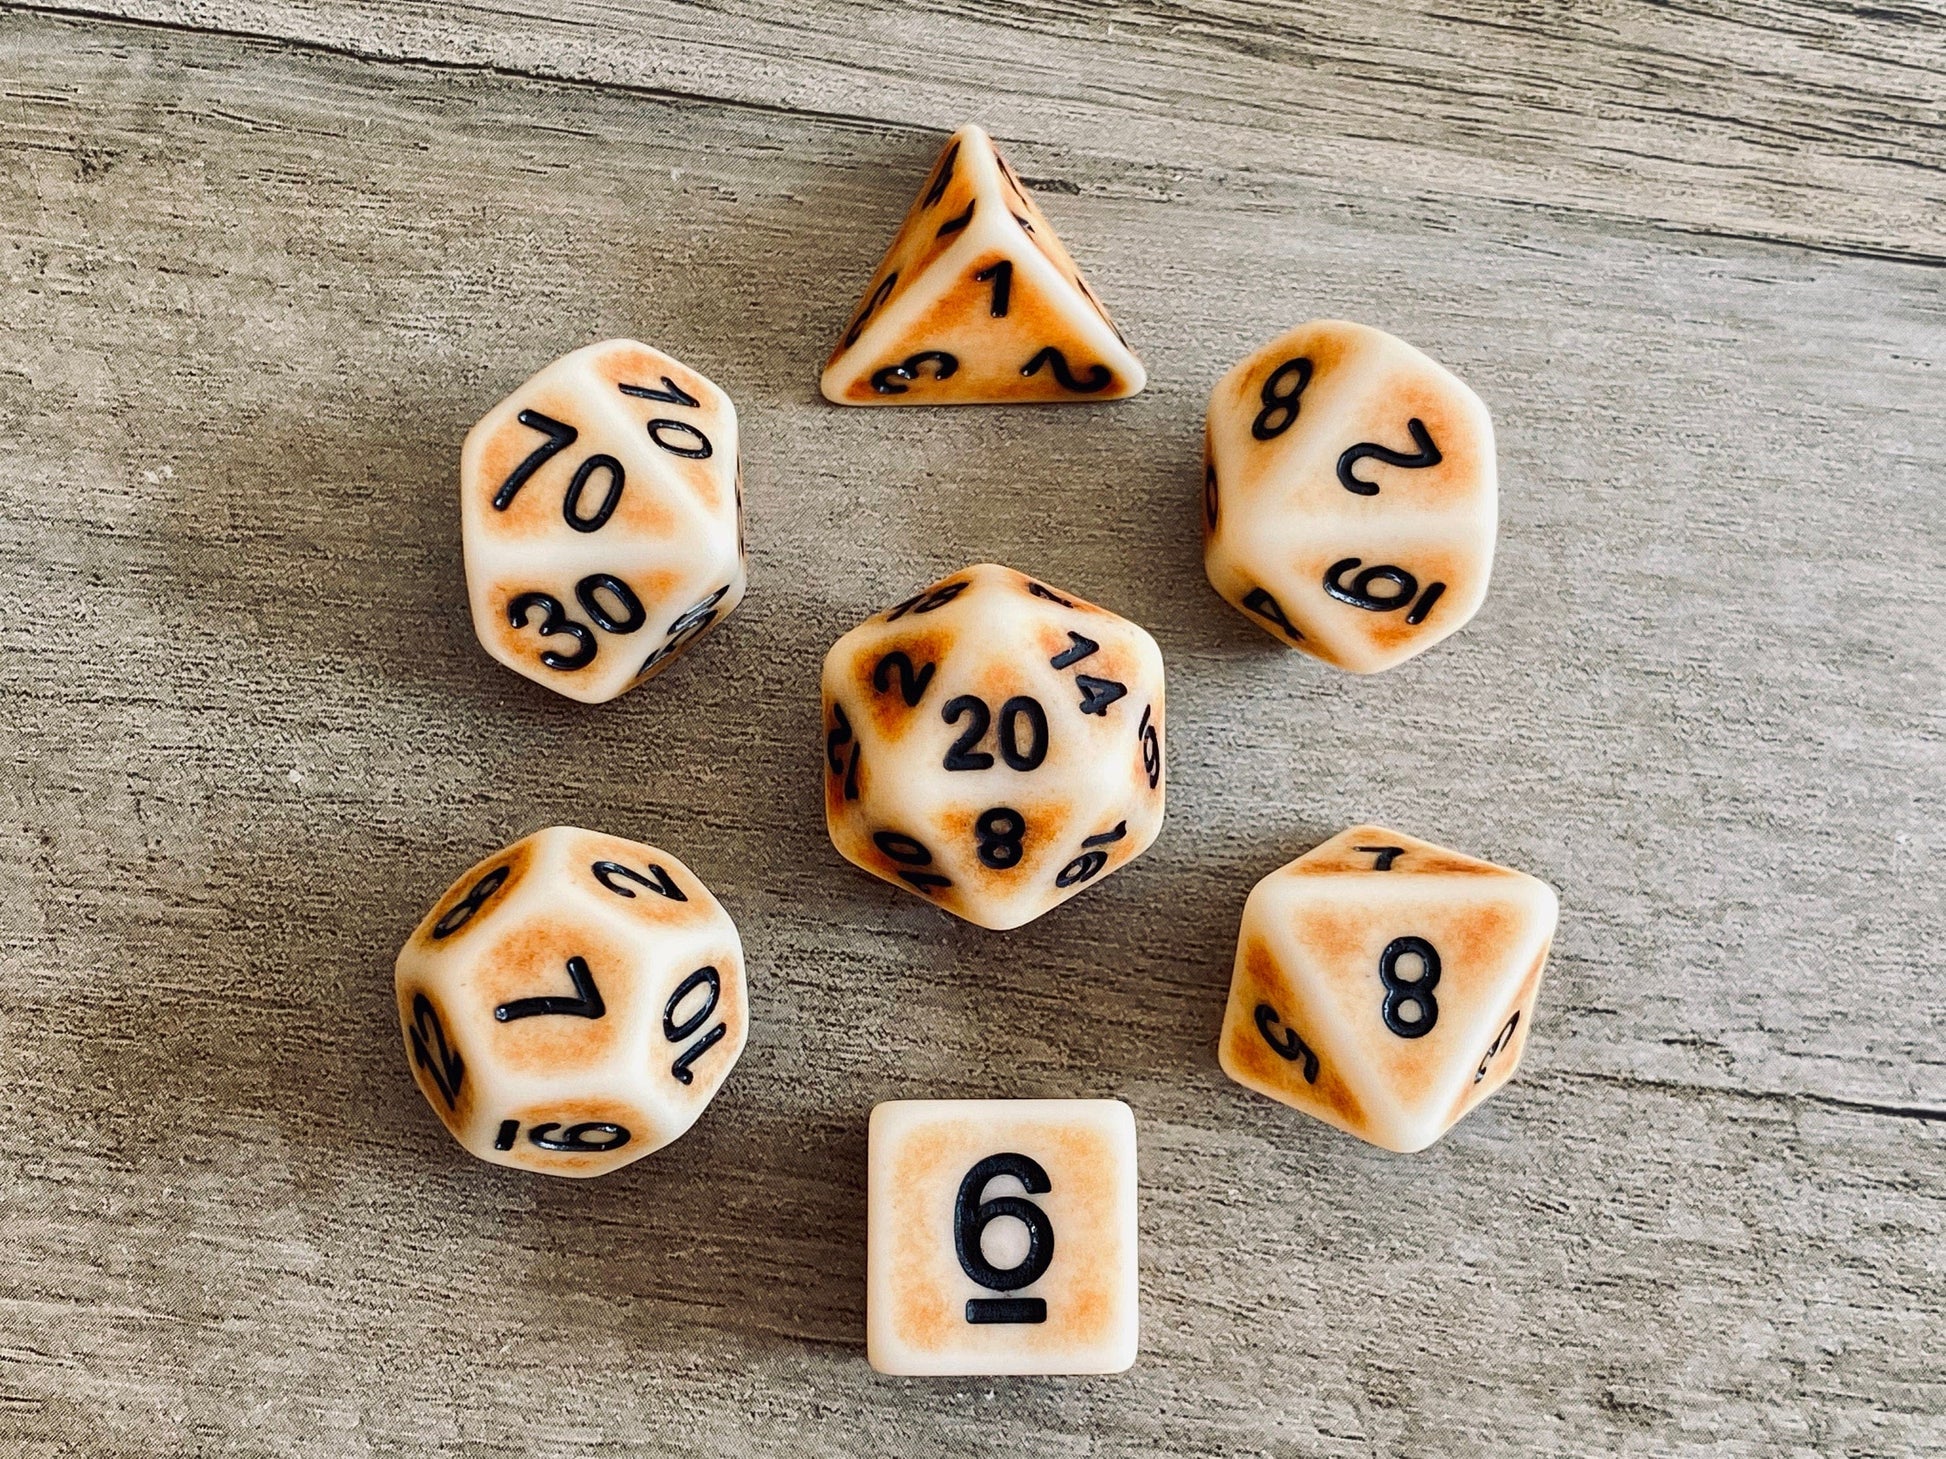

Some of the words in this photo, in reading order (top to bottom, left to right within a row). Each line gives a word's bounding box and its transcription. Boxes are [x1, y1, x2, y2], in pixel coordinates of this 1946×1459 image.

[976, 260, 1013, 318] 1
[870, 351, 959, 395] 3
[1020, 346, 1112, 393] 2
[1252, 357, 1313, 440] 8
[618, 376, 713, 459] 10
[492, 408, 626, 533] 70
[1337, 417, 1443, 496] 2
[507, 573, 647, 671] 30
[1242, 587, 1304, 641] 4
[1323, 557, 1446, 625] 6
[873, 651, 936, 707] 2
[1050, 631, 1128, 717] 14
[941, 695, 1049, 772] 20
[873, 831, 952, 895] 10
[976, 807, 1026, 870] 8
[1055, 820, 1127, 888] 16
[433, 866, 510, 939] 8
[592, 861, 688, 902] 2
[495, 956, 605, 1022] 7
[1379, 936, 1441, 1039] 8
[409, 993, 464, 1111] 12
[664, 966, 726, 1085] 10
[1254, 1004, 1320, 1085] 5
[954, 1152, 1055, 1324] 6
